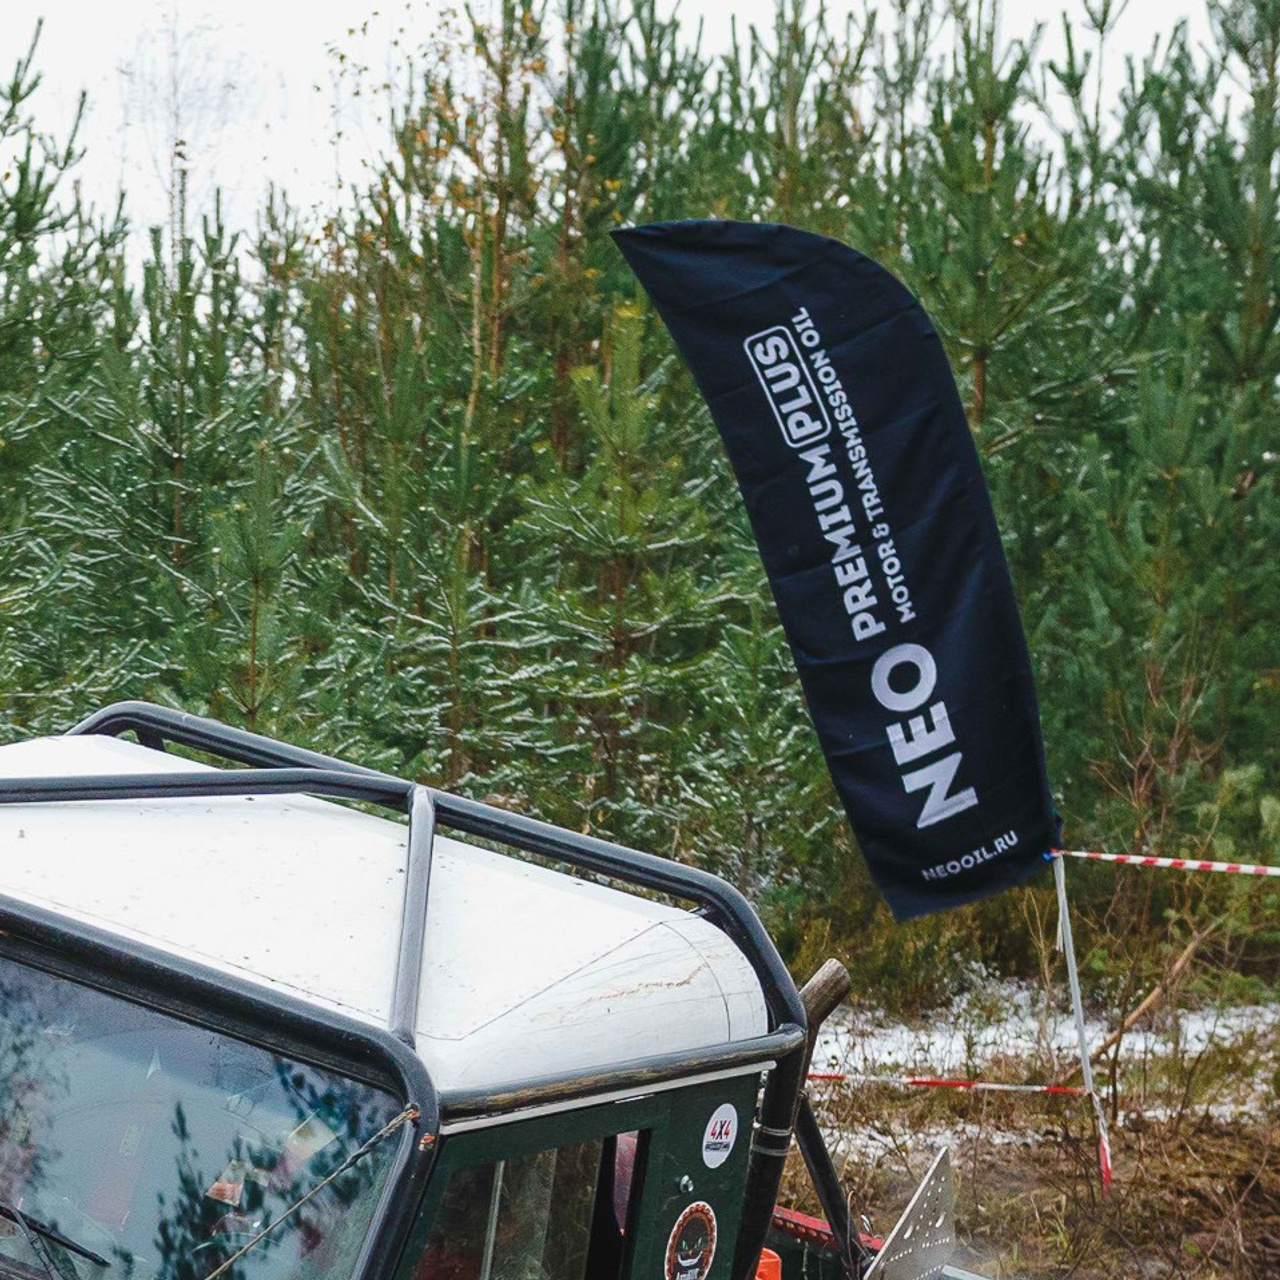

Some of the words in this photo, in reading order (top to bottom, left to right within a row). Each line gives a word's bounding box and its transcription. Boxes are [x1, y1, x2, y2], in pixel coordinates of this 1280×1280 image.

[791, 307, 820, 347] OIL
[753, 335, 823, 440] PLUS
[809, 349, 885, 522] TRANSMISSION
[798, 443, 887, 641] PREMIUM
[872, 522, 890, 539] &
[877, 538, 916, 624] MOTOR
[871, 643, 979, 828] NEO
[922, 830, 1018, 880] NEOOIL.RU
